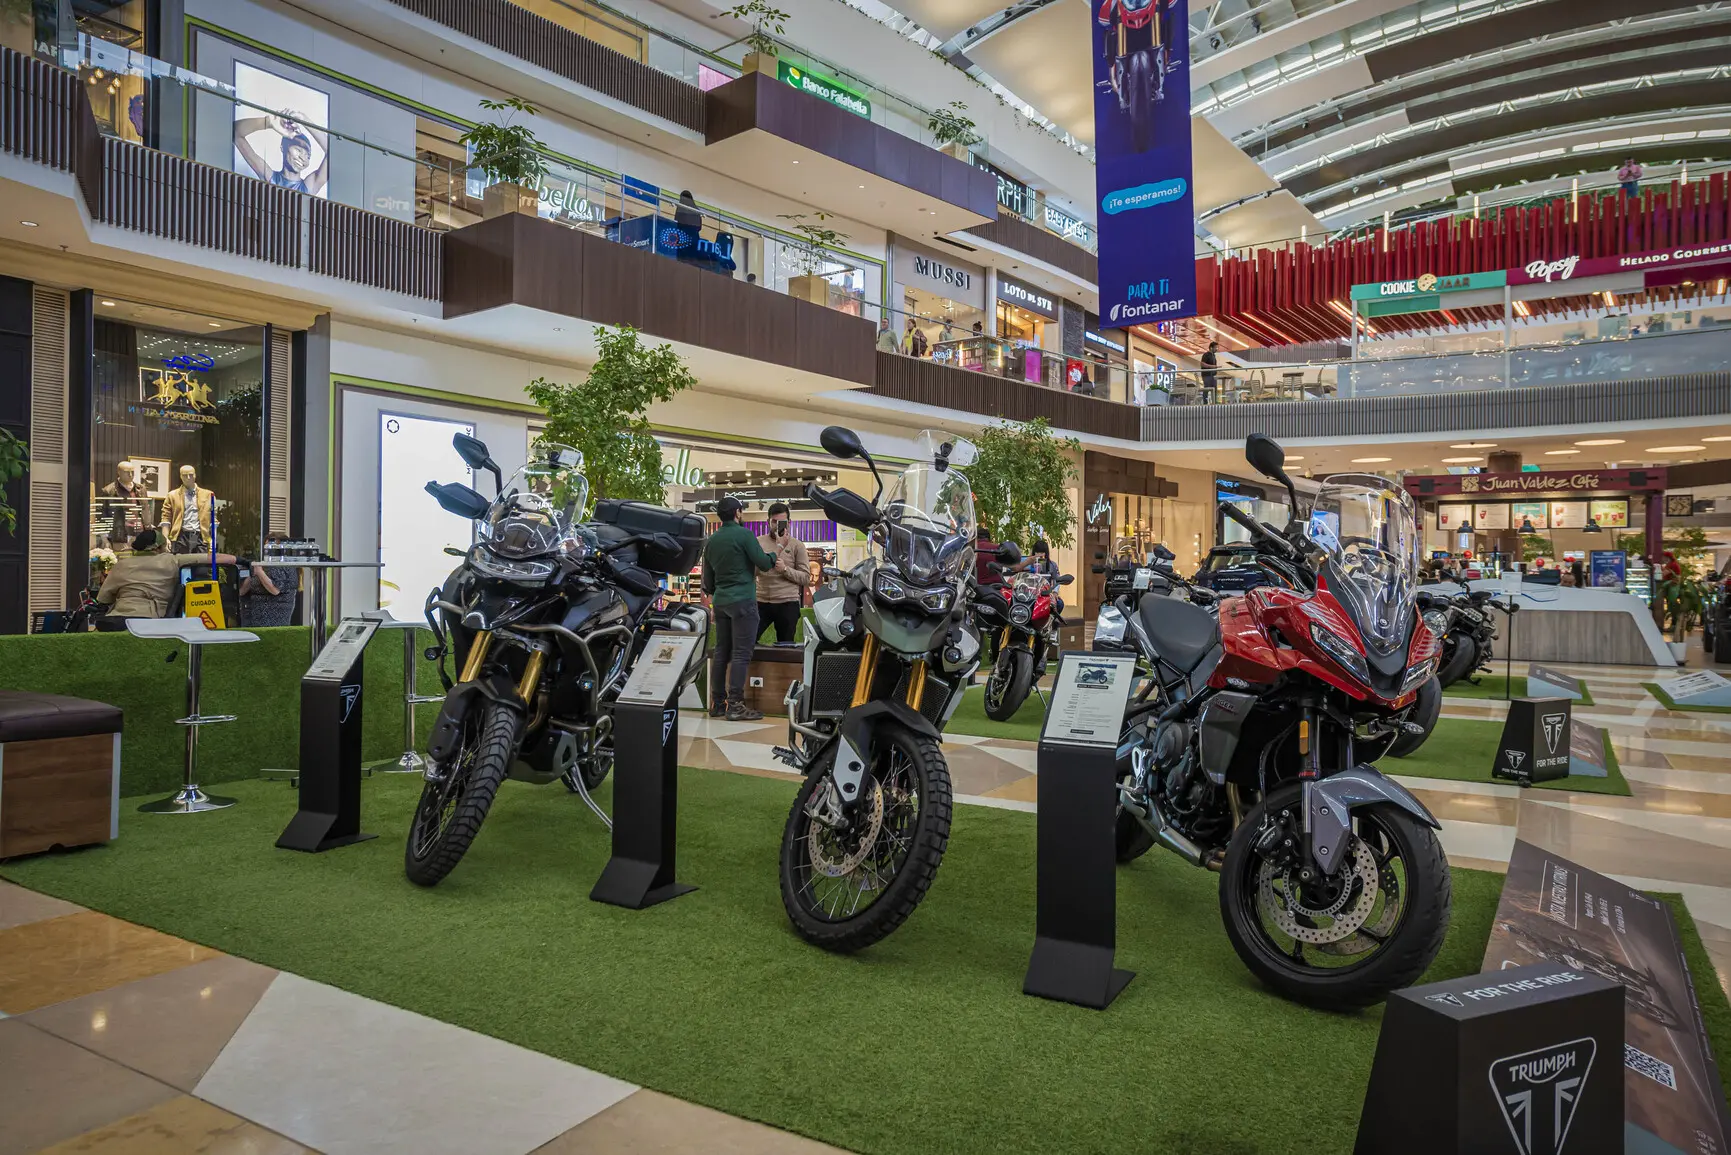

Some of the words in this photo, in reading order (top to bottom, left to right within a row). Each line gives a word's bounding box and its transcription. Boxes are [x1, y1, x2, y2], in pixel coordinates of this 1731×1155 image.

[802, 77, 830, 97] Banco
[830, 89, 867, 114] Falabella
[1109, 199, 1122, 208] ¡Te
[1125, 184, 1181, 204] esperamos!
[1525, 255, 1580, 283] Popsy
[1620, 253, 1669, 266] HELADO
[914, 256, 970, 290] MUSSI
[1004, 282, 1026, 300] LOTO
[1128, 281, 1155, 300] PARA
[1380, 281, 1416, 295] COOKIE
[1438, 277, 1471, 290] JAAR
[1122, 299, 1185, 318] fontanar
[1483, 476, 1518, 490] Juan
[1519, 477, 1570, 490] Valdez
[1571, 474, 1599, 488] Café
[1536, 759, 1546, 768] FOR
[1547, 758, 1556, 766] THE
[1557, 756, 1568, 765] RIDE
[1463, 986, 1508, 1000] FOR
[1498, 979, 1544, 993] THE
[1535, 972, 1584, 986] RIDE
[1509, 1051, 1576, 1083] TRIUMPH
